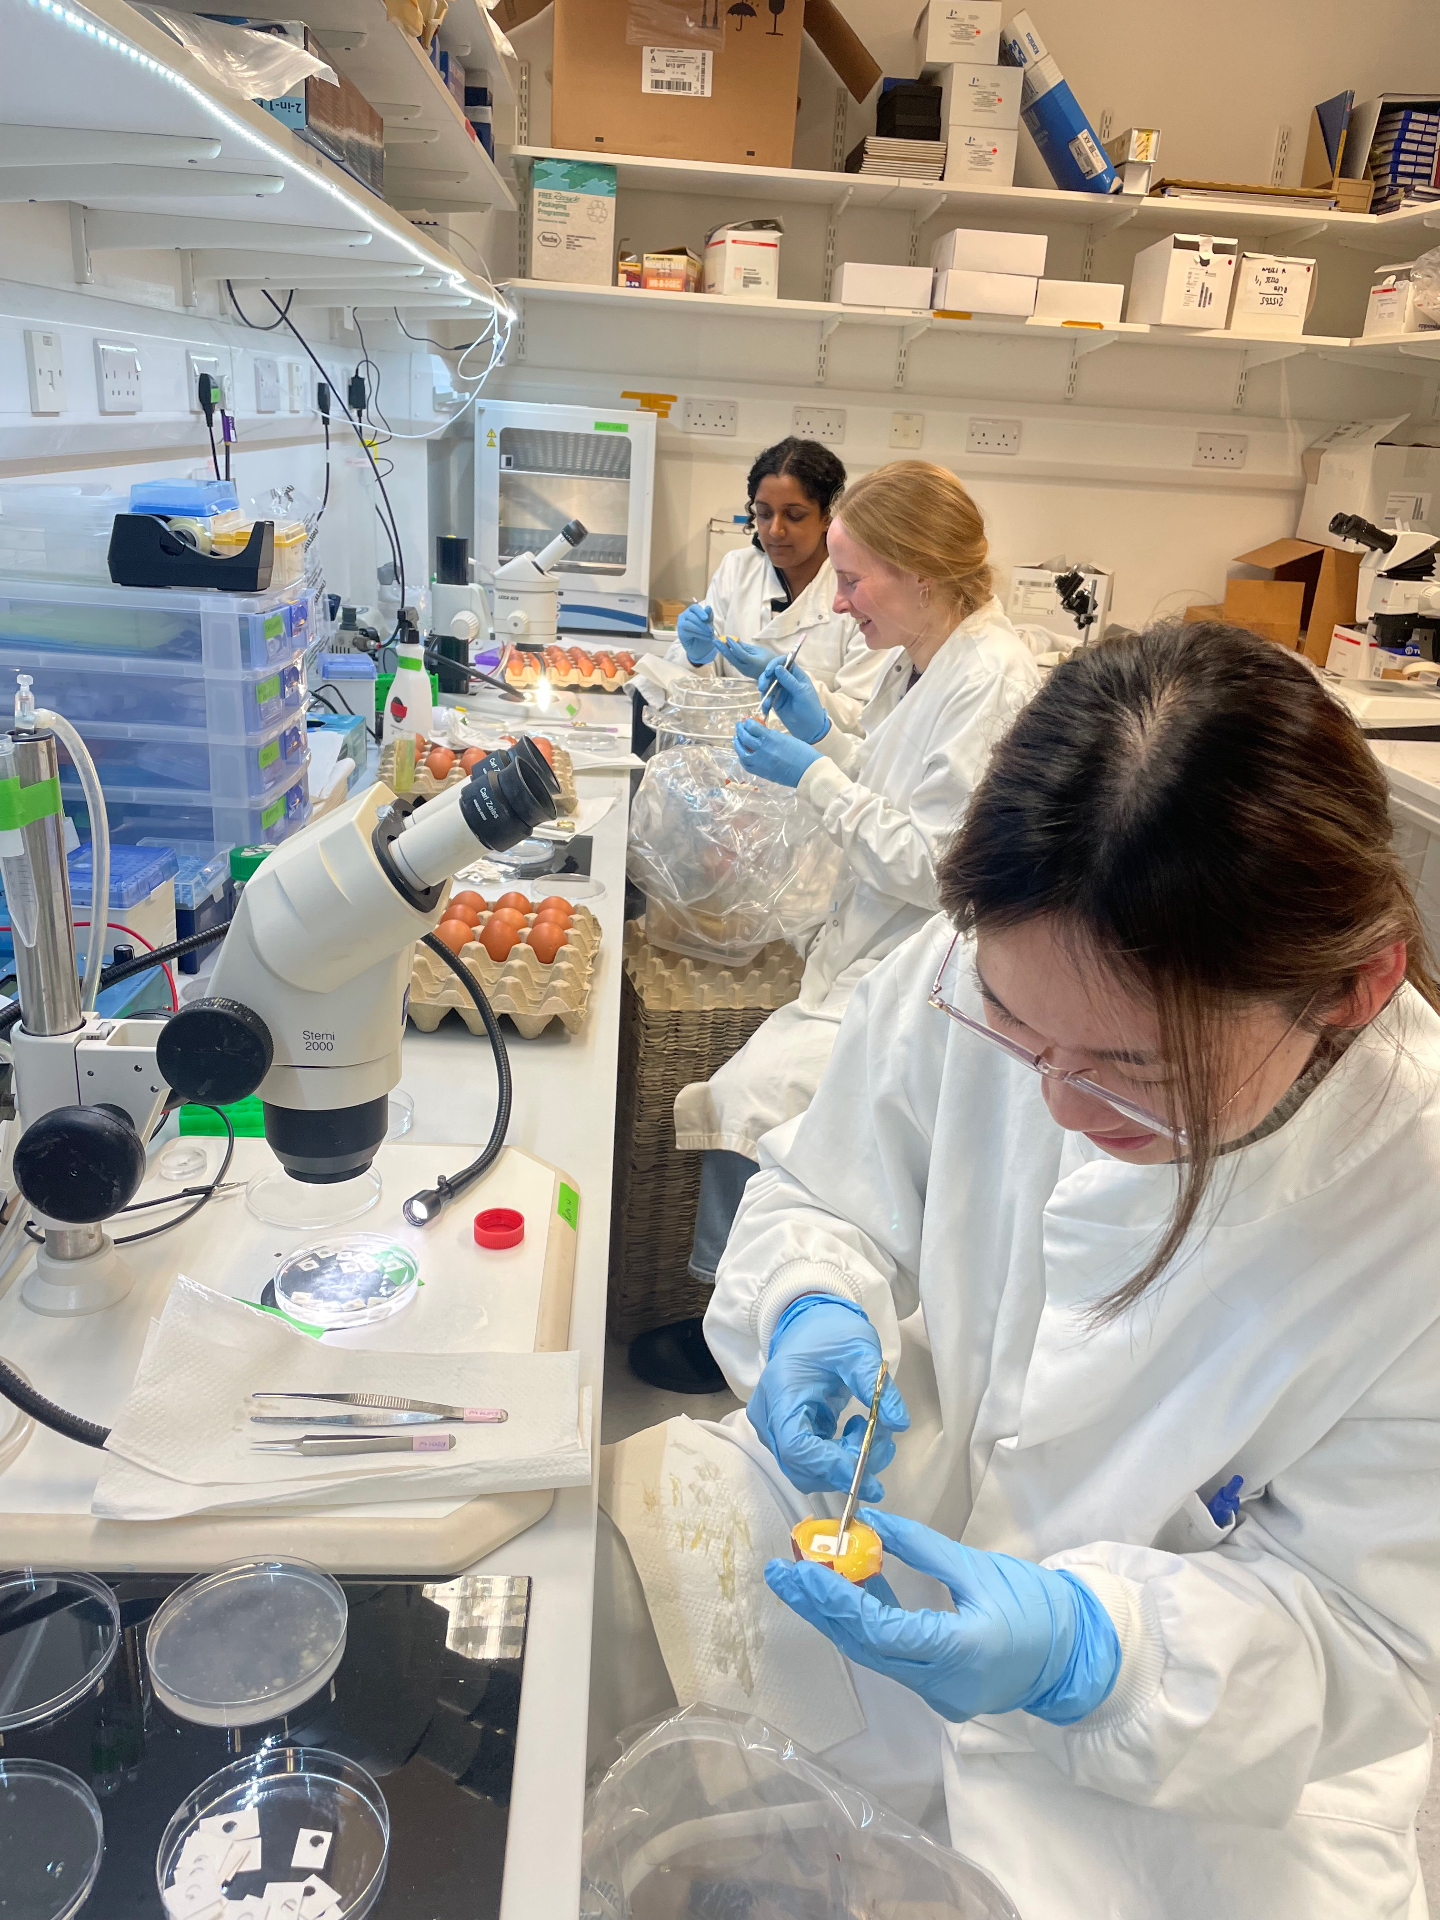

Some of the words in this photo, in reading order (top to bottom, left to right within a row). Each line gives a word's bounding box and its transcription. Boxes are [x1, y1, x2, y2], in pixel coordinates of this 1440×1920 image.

[1026, 32, 1040, 55] Konica
[269, 100, 302, 114] 2-in-1
[538, 191, 552, 199] FREE
[537, 200, 567, 211] Packaging
[541, 234, 558, 244] Roche
[489, 757, 497, 769] Carl
[480, 787, 489, 801] Carl
[486, 800, 499, 819] Zeiss
[302, 1030, 335, 1041] Stemi
[305, 1041, 334, 1051] 2000
